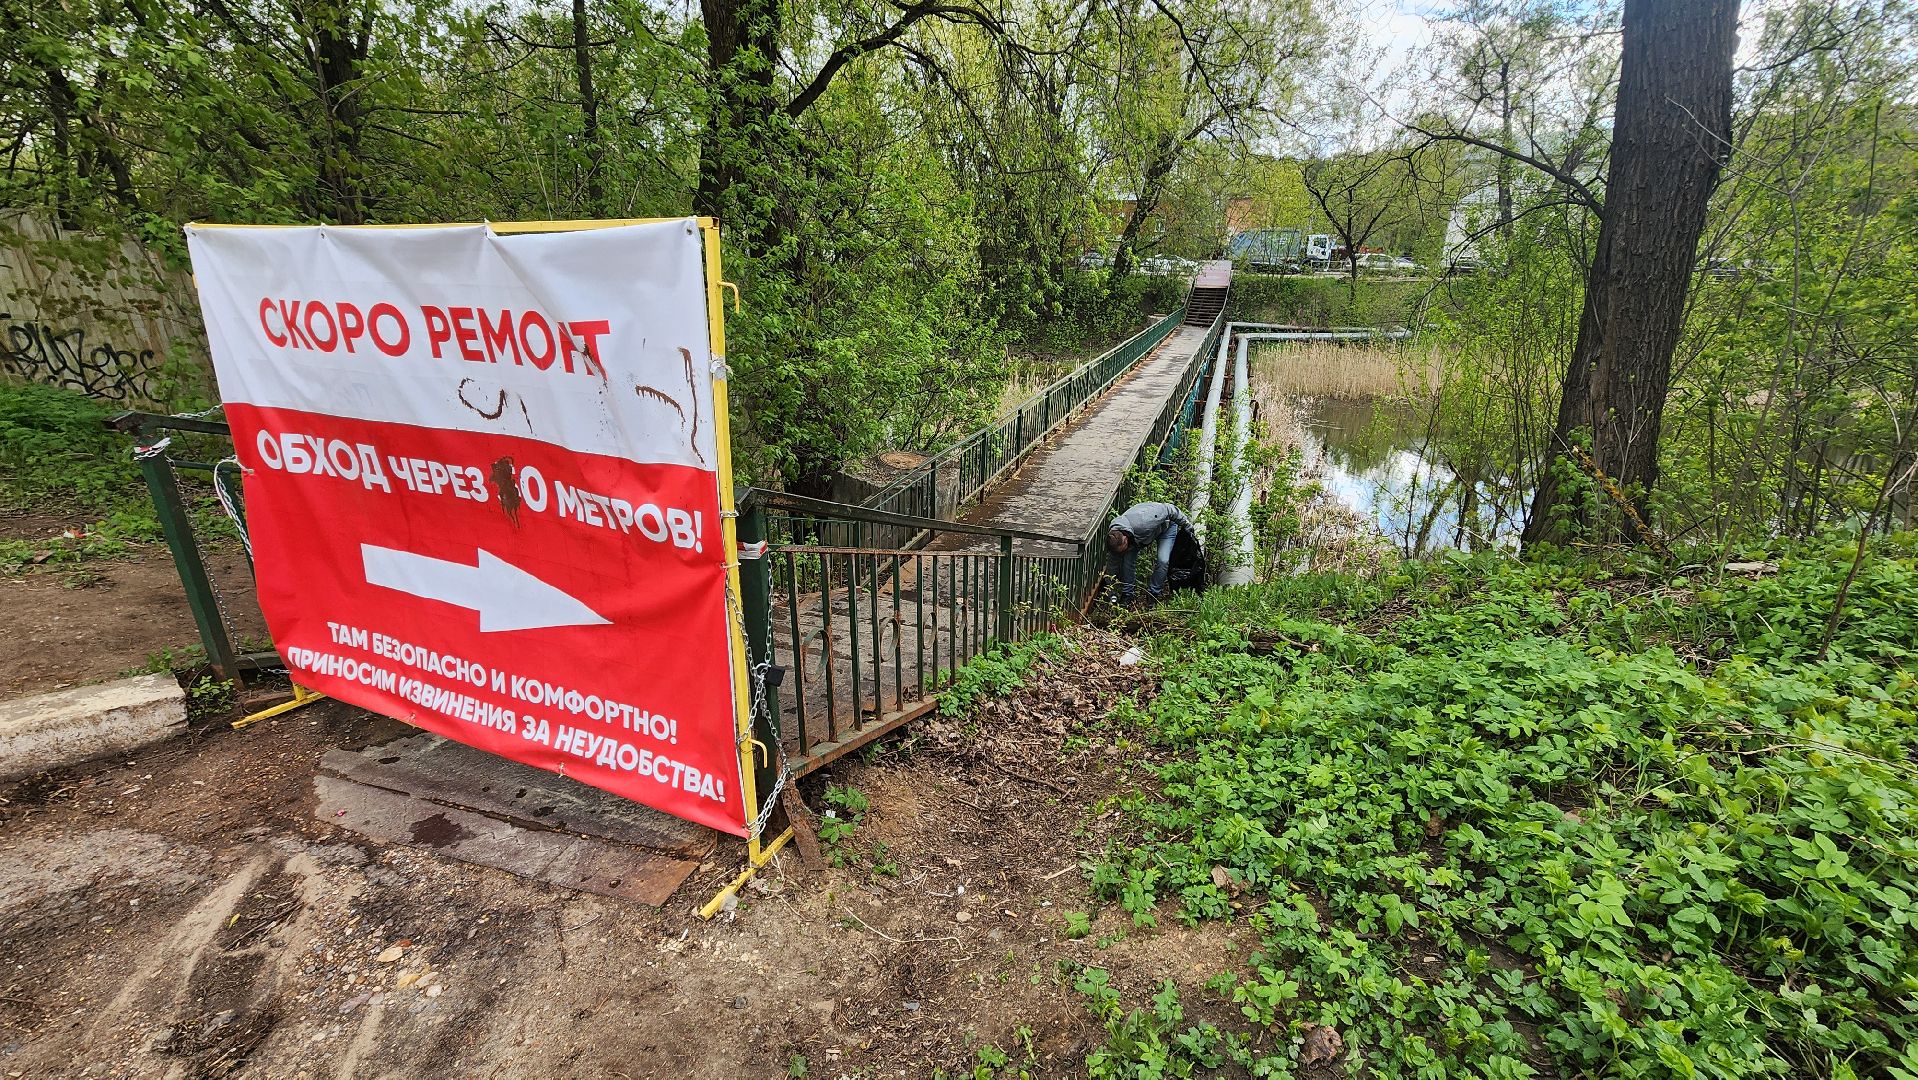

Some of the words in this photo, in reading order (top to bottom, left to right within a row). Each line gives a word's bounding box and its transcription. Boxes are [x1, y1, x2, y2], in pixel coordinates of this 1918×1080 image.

[259, 297, 411, 357] СКОРО
[420, 305, 611, 381] РЕМОНТ
[256, 429, 391, 493] ОБХОД
[387, 457, 489, 503] ЧЕРЕЗ
[490, 459, 548, 513] 0
[554, 480, 704, 554] МЕТРОВ!
[287, 646, 396, 695] ПРИНОСИМ
[398, 676, 517, 735] ИЗВИНЕНИЯ
[521, 714, 551, 745] ЗА
[553, 726, 727, 803] НЕУДОБСТВА!
[327, 621, 369, 652] ТАМ
[372, 632, 487, 687] БЕЗОПАСНО
[490, 668, 507, 694] И
[511, 675, 678, 745] КОМФОРТНО!
